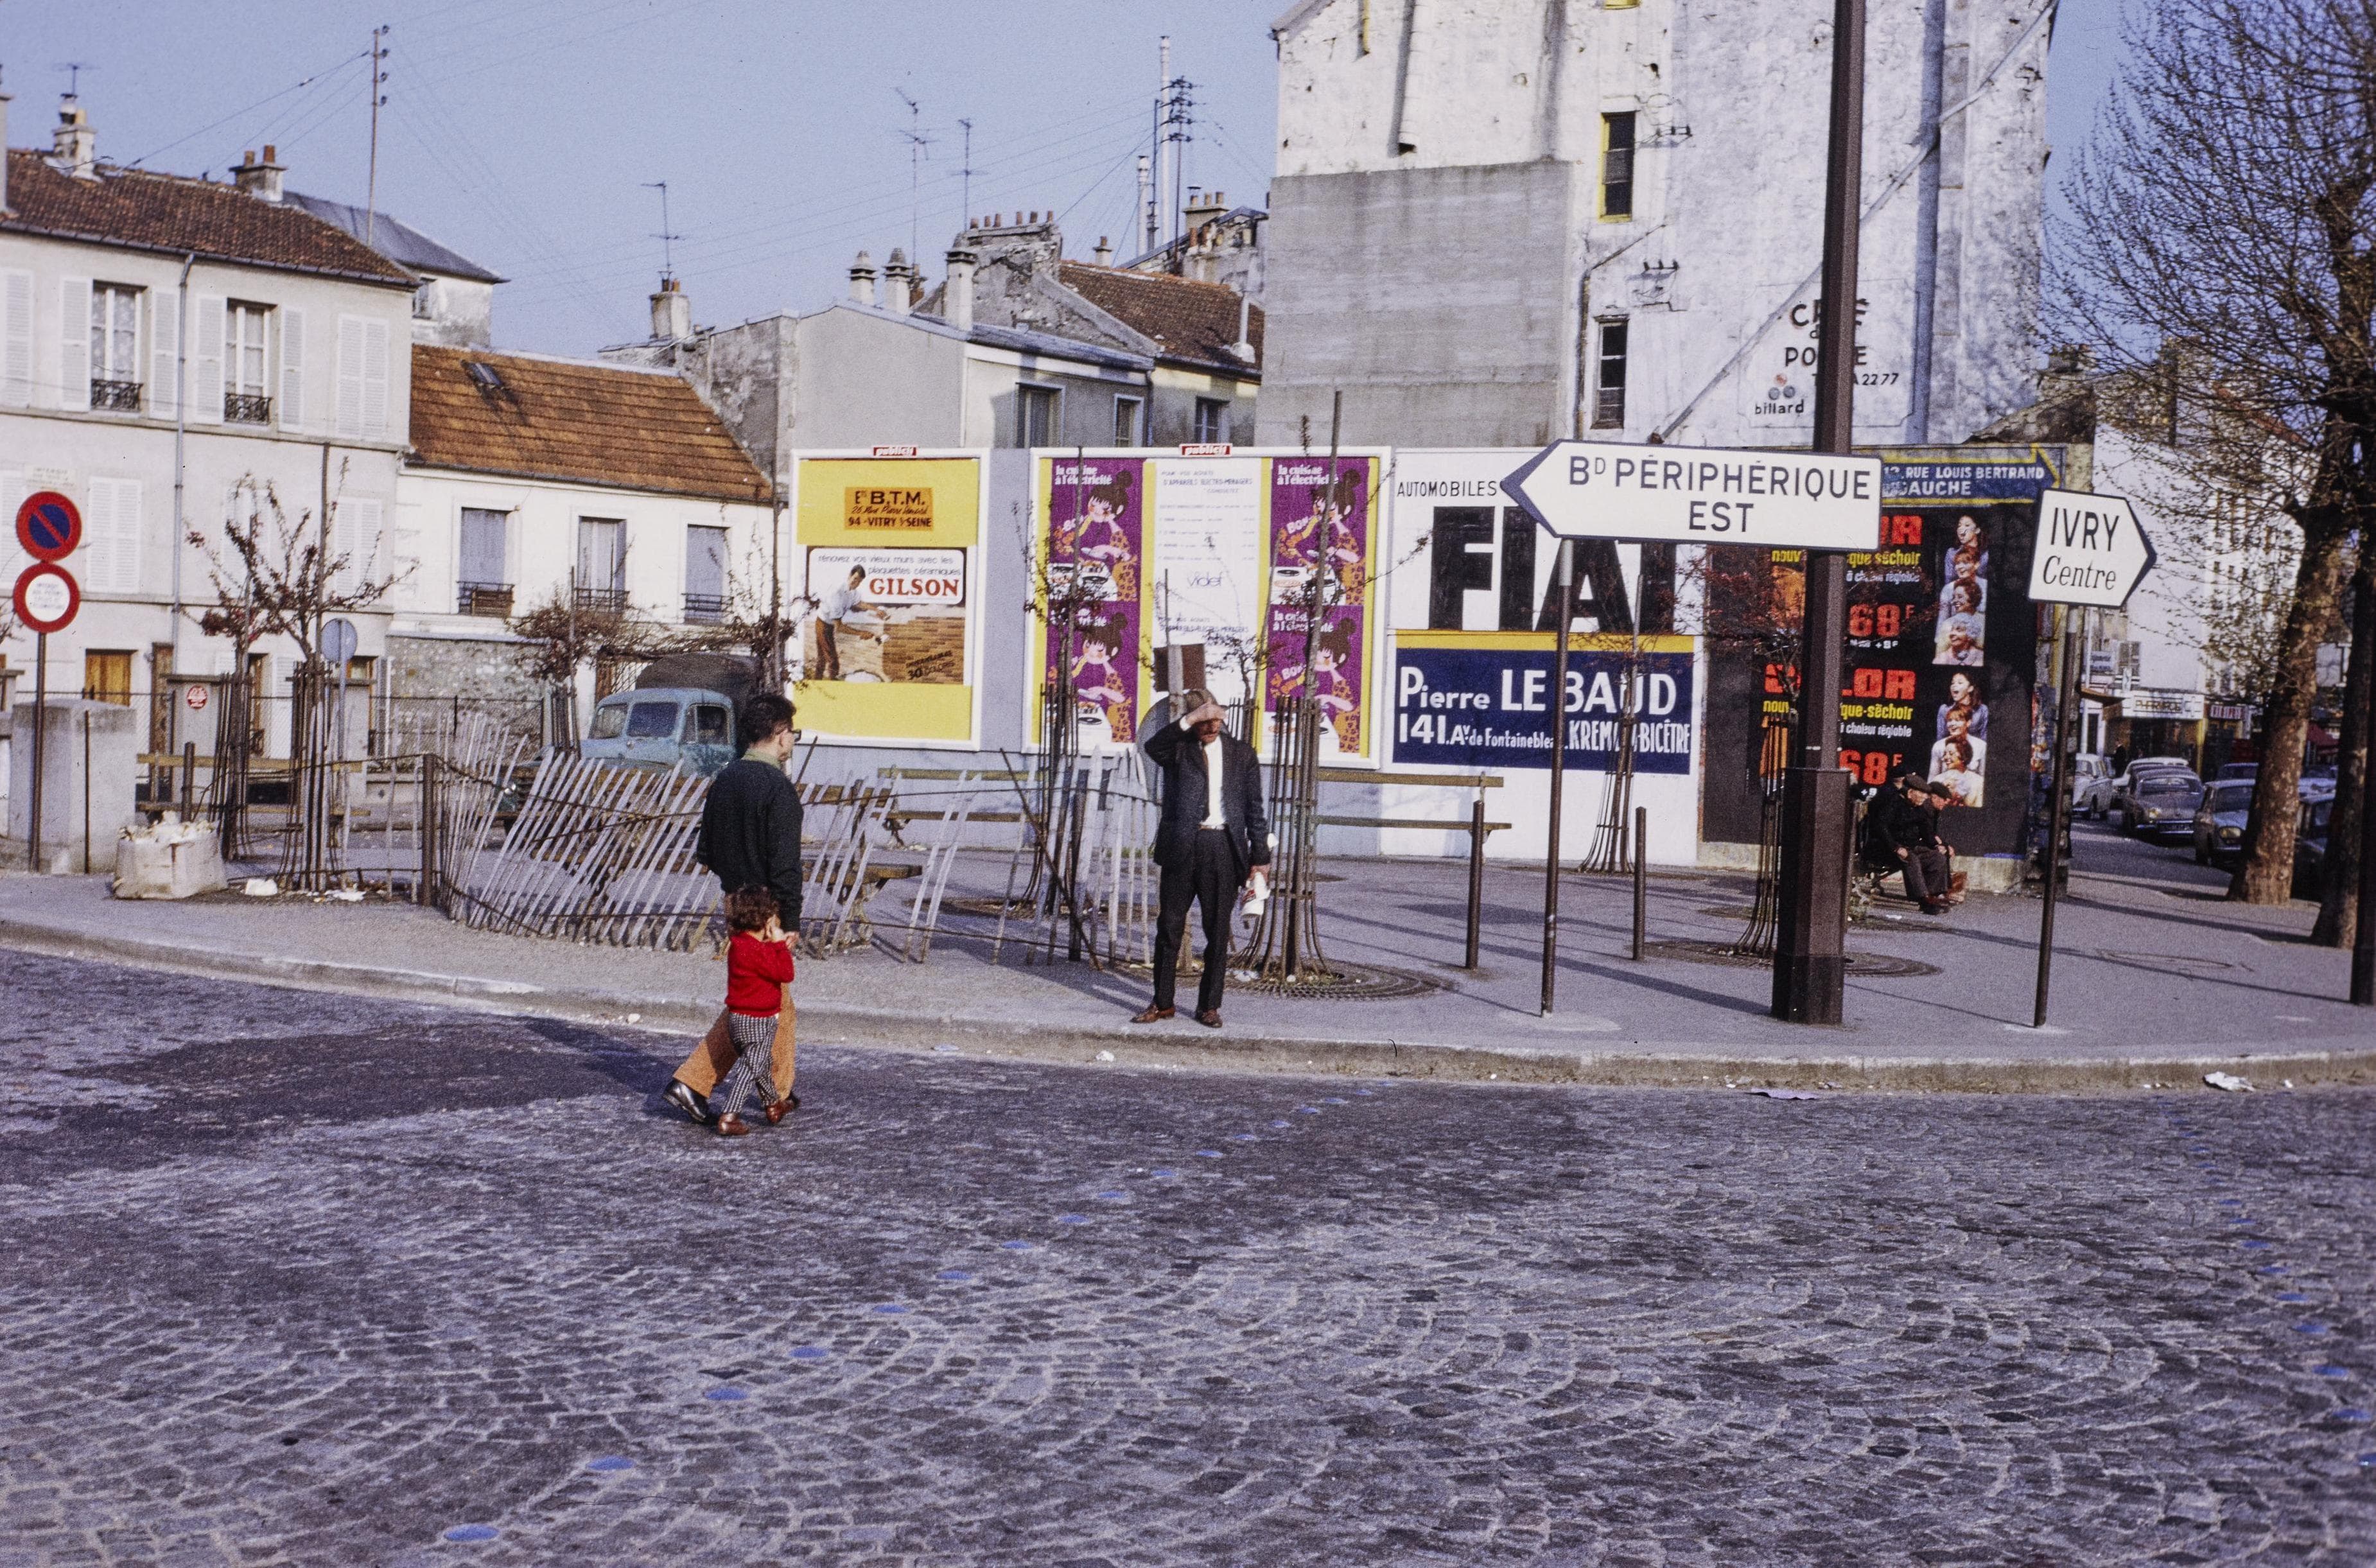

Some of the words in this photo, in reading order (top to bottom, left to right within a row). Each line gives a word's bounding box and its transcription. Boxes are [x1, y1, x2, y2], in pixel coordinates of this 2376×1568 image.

[1785, 345, 1867, 367] POE
[1755, 399, 1804, 415] billard
[1615, 455, 1871, 501] PÉRIPHÉRIQUE
[1905, 466, 1930, 479] RUE
[1935, 466, 1972, 479] LOUIS
[1975, 467, 2045, 480] BERTRAND
[1397, 481, 1497, 497] AUTOMOBILES
[1688, 501, 1754, 533] EST
[2050, 507, 2120, 552] IVRY
[2043, 555, 2117, 591] Centre
[869, 577, 960, 597] GILSON
[1399, 666, 1490, 710] Pierre
[1501, 669, 1546, 711] LE
[1563, 671, 1677, 715] BAUD
[1469, 728, 1483, 746] de
